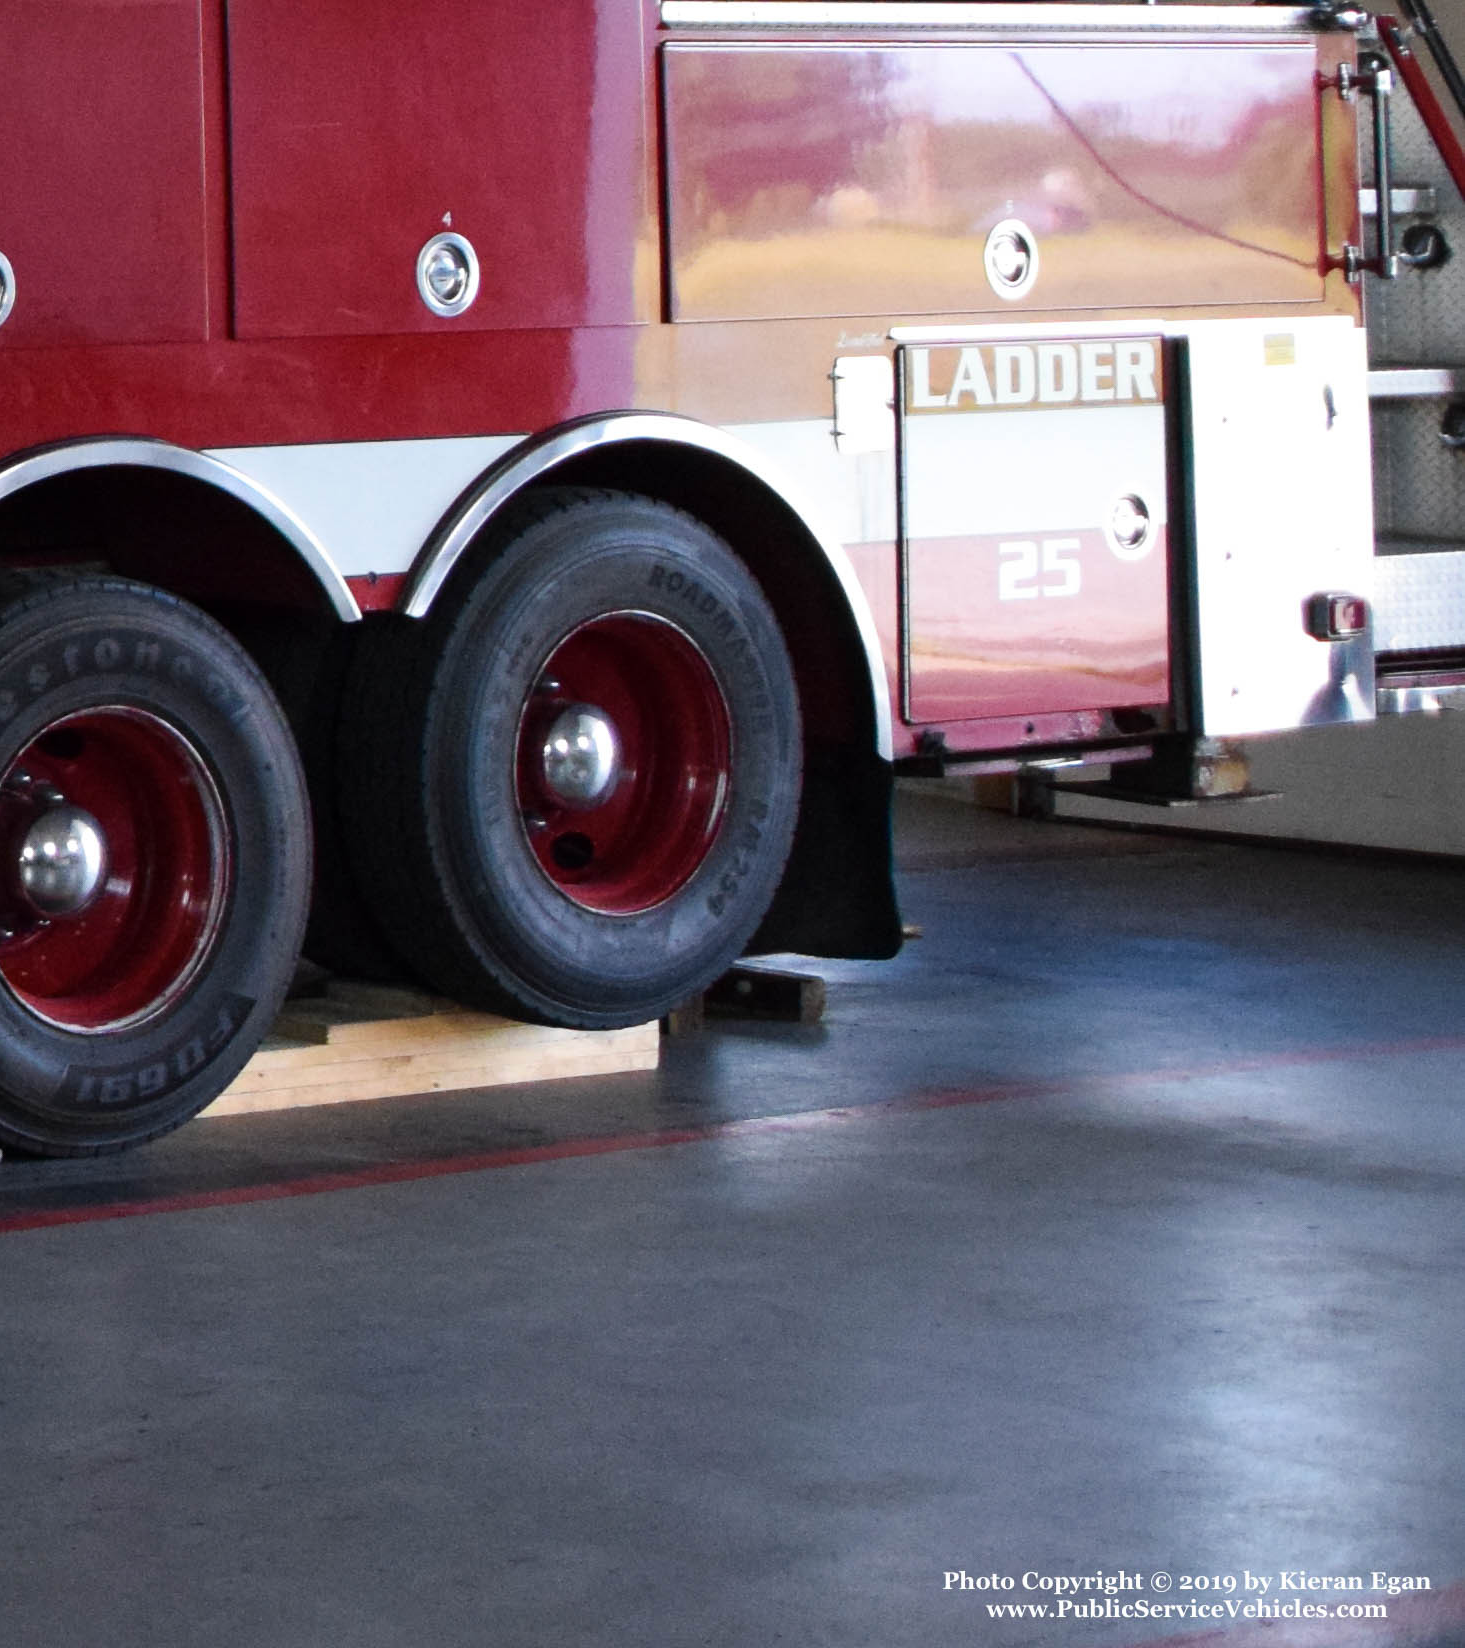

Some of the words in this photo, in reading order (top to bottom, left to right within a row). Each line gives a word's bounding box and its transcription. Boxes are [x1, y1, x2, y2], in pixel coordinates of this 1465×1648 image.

[442, 211, 451, 227] 4
[910, 341, 1158, 409] LADDER
[998, 538, 1081, 601] 25
